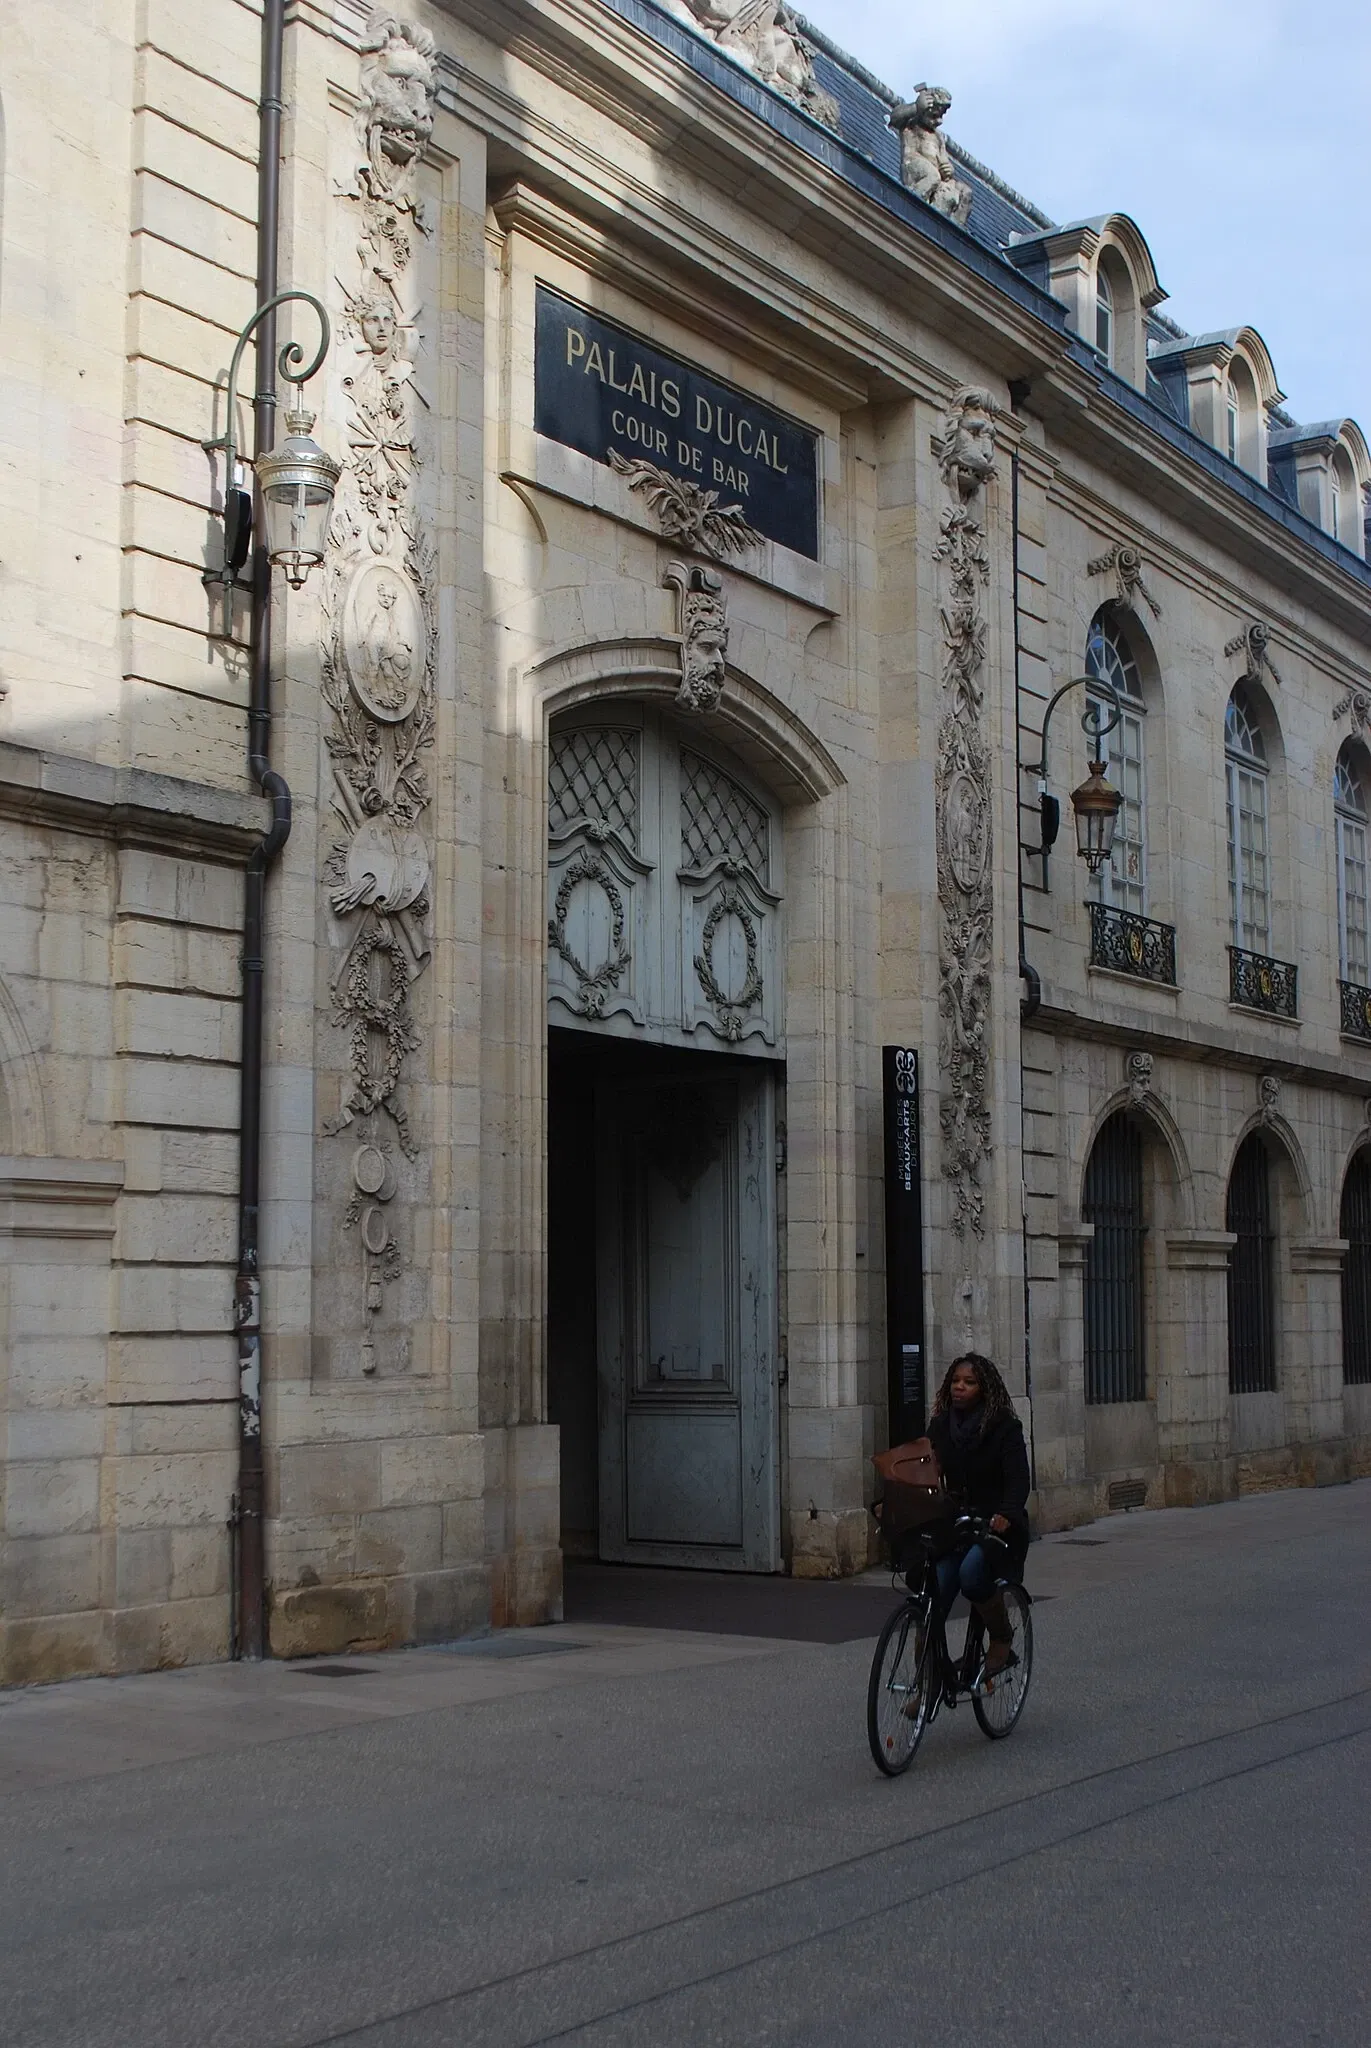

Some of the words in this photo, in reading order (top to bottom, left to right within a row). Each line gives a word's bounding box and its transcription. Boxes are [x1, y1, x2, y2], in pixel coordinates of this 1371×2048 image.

[566, 327, 681, 418] PALAIS
[695, 394, 788, 474] DUCAL
[611, 410, 668, 457] COUR
[677, 440, 703, 473] DE
[712, 457, 750, 497] BAR
[896, 1098, 904, 1127] DES
[903, 1099, 912, 1191] BEAUX-ARTS
[909, 1100, 917, 1143] DIJON
[911, 1147, 918, 1167] DE
